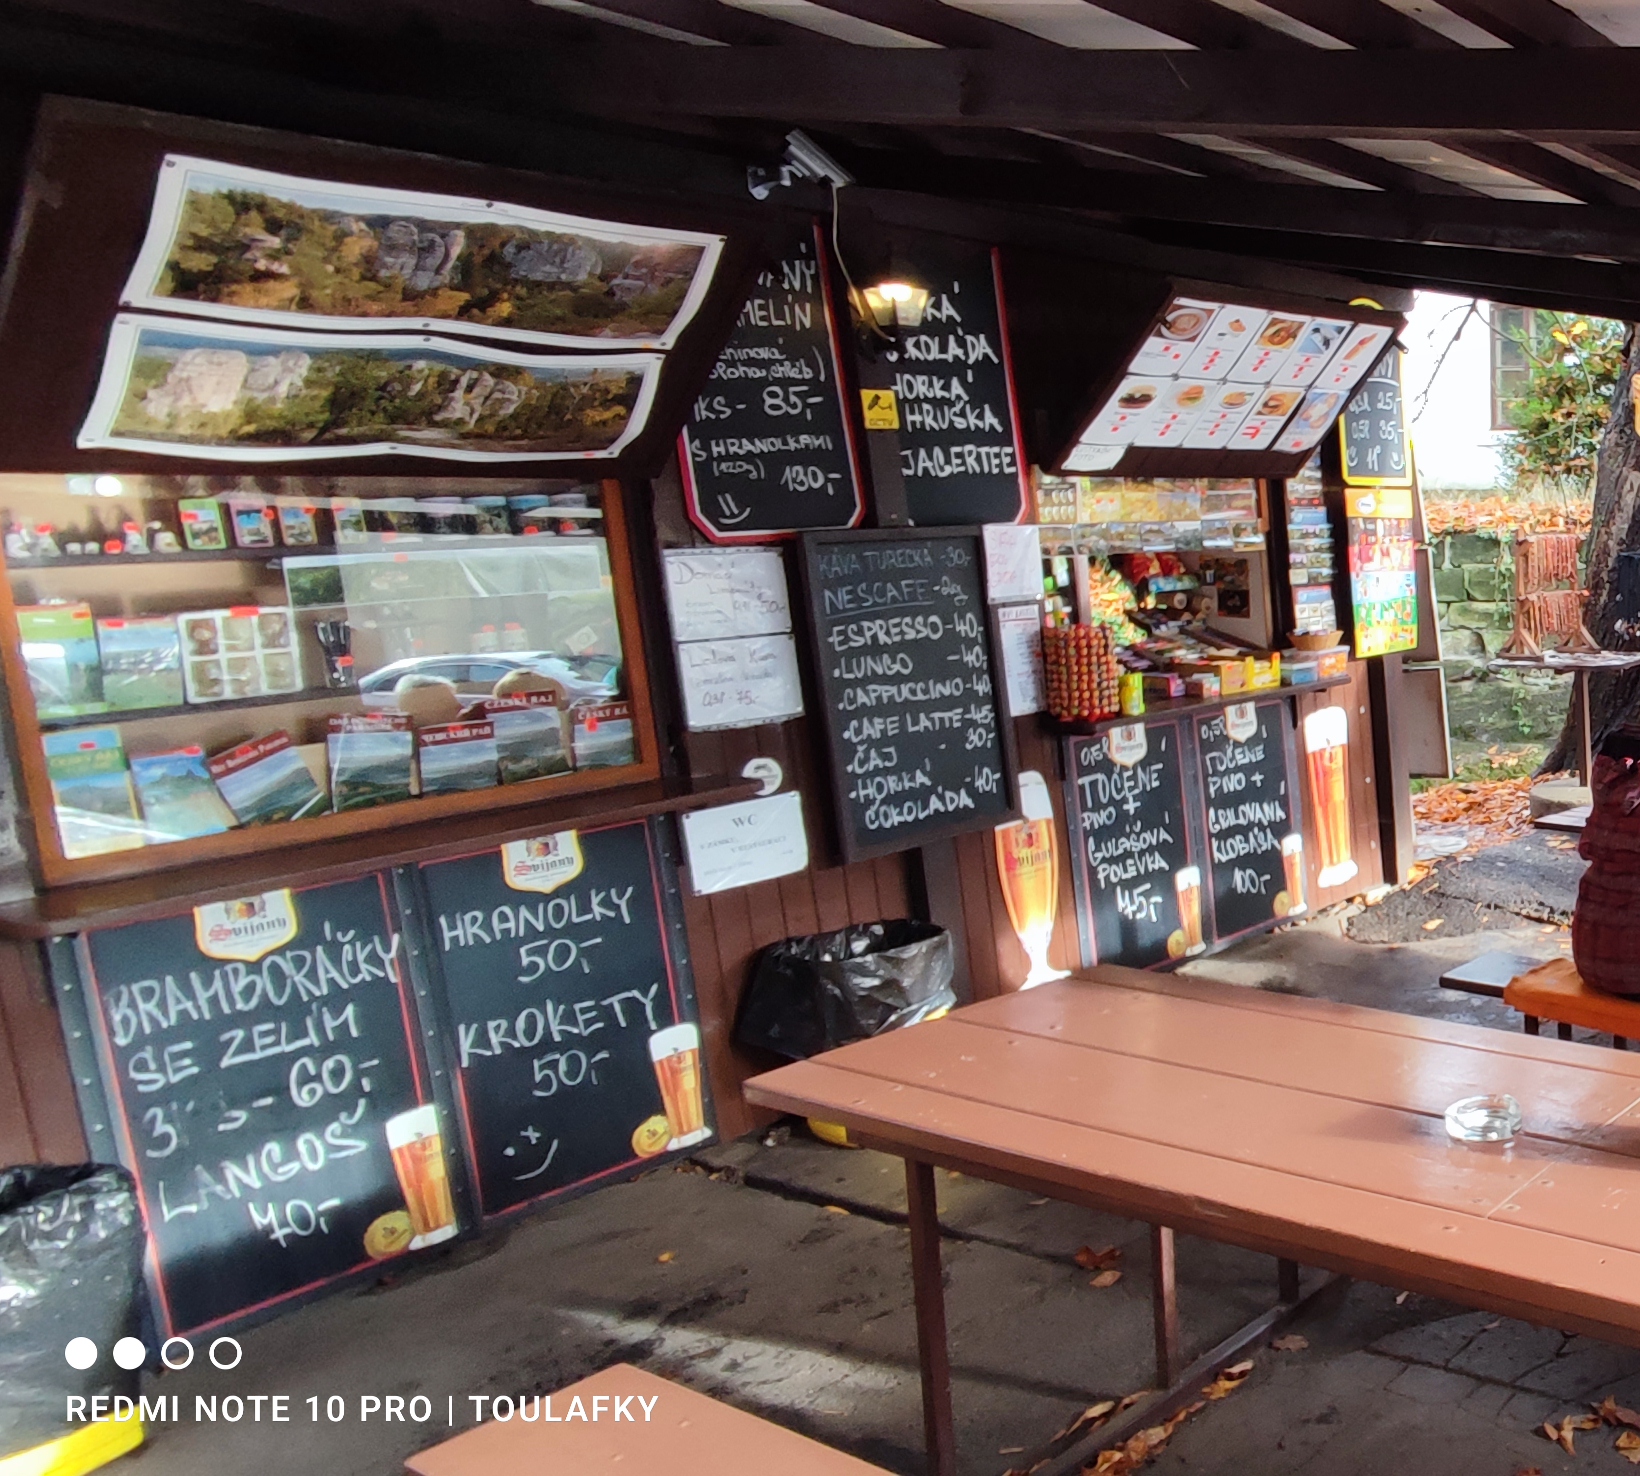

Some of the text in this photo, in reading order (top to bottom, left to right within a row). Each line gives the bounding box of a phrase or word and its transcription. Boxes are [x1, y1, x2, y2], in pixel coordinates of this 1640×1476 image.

[905, 400, 1003, 432] HRUŠKA
[832, 615, 943, 651] ESPRESSO
[840, 653, 913, 679] LUNGO
[843, 677, 963, 710] CAPPUCCINO
[850, 716, 900, 743] CAFE
[906, 708, 964, 732] LATTE
[854, 743, 898, 775] ČAJ
[732, 813, 758, 828] WC
[865, 786, 975, 829] ČOKOLÁDA
[513, 856, 574, 877] Svijany
[208, 917, 287, 943] Svijany
[439, 886, 633, 951] HRANOLKY
[106, 921, 400, 1047] BRAMBORÁČKY
[458, 983, 658, 1067] KROKETY
[128, 1040, 200, 1093] SE
[158, 1098, 368, 1223] LANGOŠ
